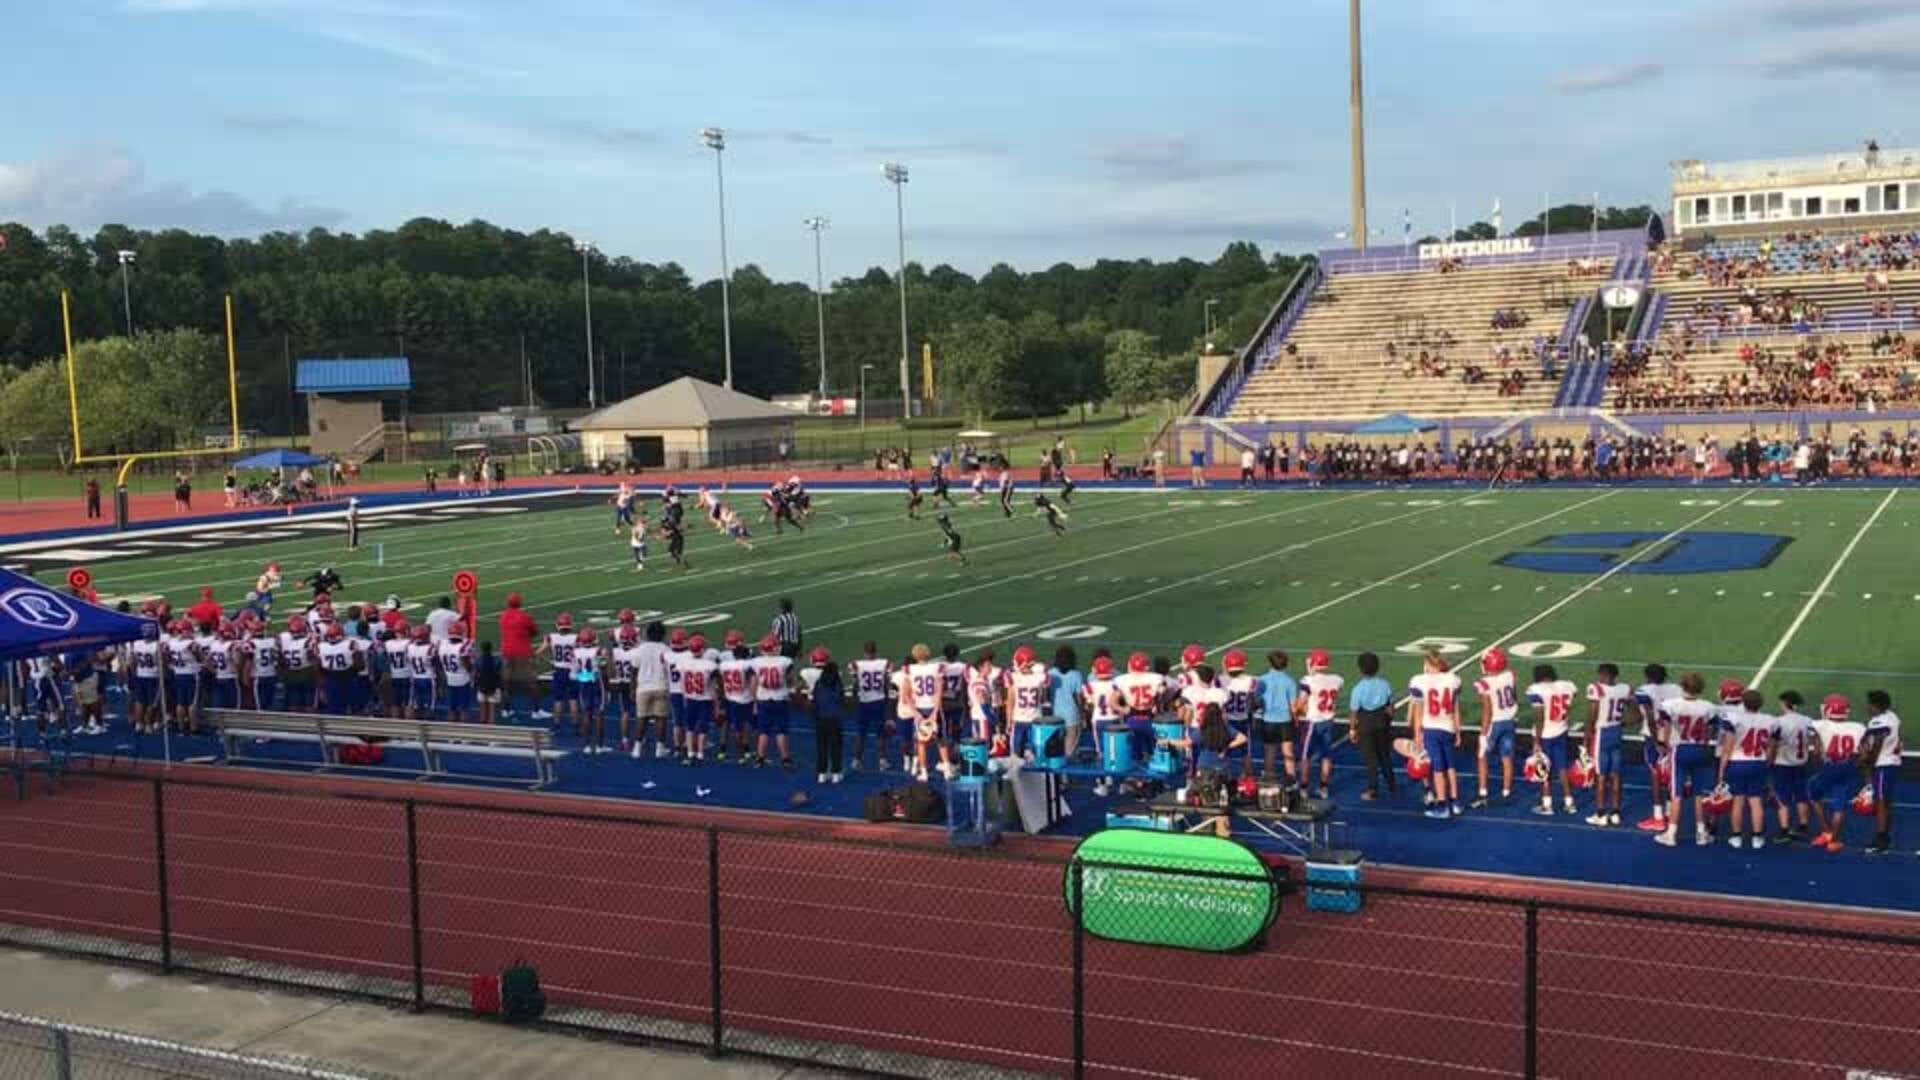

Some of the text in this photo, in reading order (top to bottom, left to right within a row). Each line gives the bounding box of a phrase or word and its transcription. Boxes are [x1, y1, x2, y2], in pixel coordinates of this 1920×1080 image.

[1419, 238, 1536, 259] CENTENNIAL
[861, 671, 882, 691] 35
[914, 674, 936, 697] 38
[1018, 687, 1039, 709] 53
[1428, 687, 1453, 716] 64
